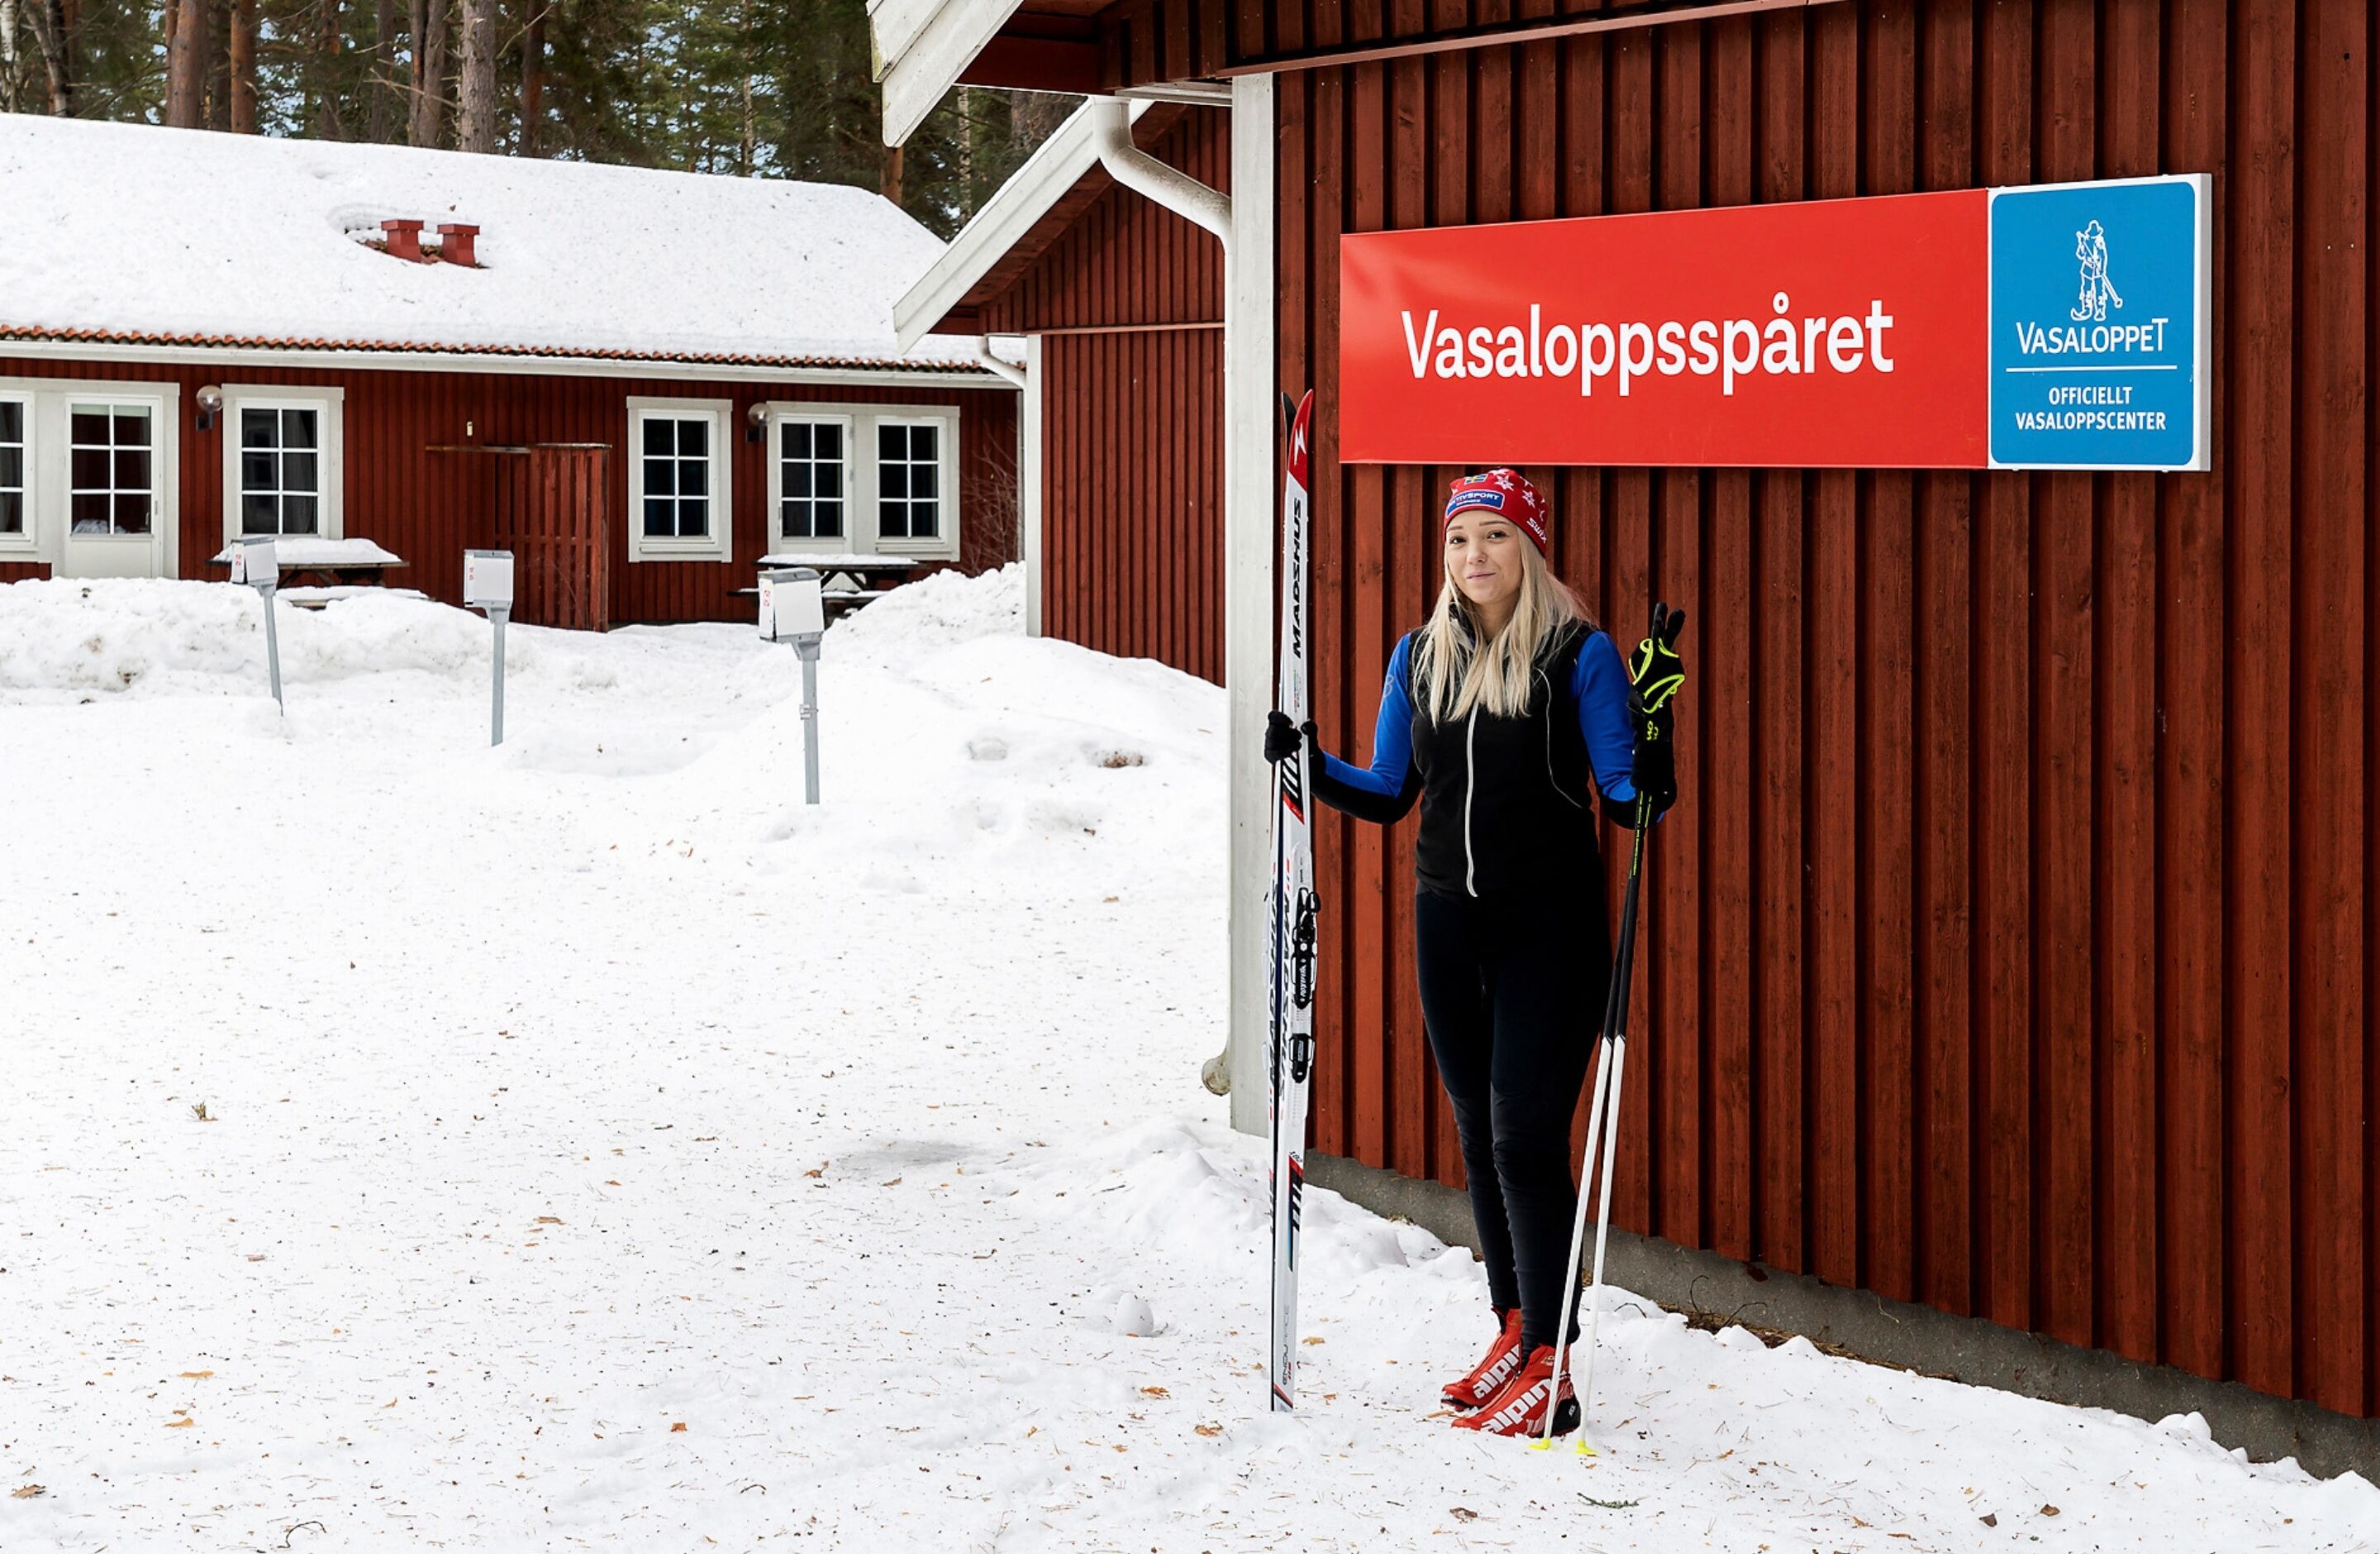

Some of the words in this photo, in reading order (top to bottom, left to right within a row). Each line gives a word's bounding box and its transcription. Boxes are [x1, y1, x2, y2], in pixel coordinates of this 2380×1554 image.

[1401, 292, 1894, 397] Vasaloppsspåret
[2016, 318, 2168, 354] VASALOPPET
[2049, 387, 2133, 405] OFFICIELLT
[2016, 412, 2167, 430] VASALOPPSCENTER
[1292, 498, 1302, 659] MADSHUS
